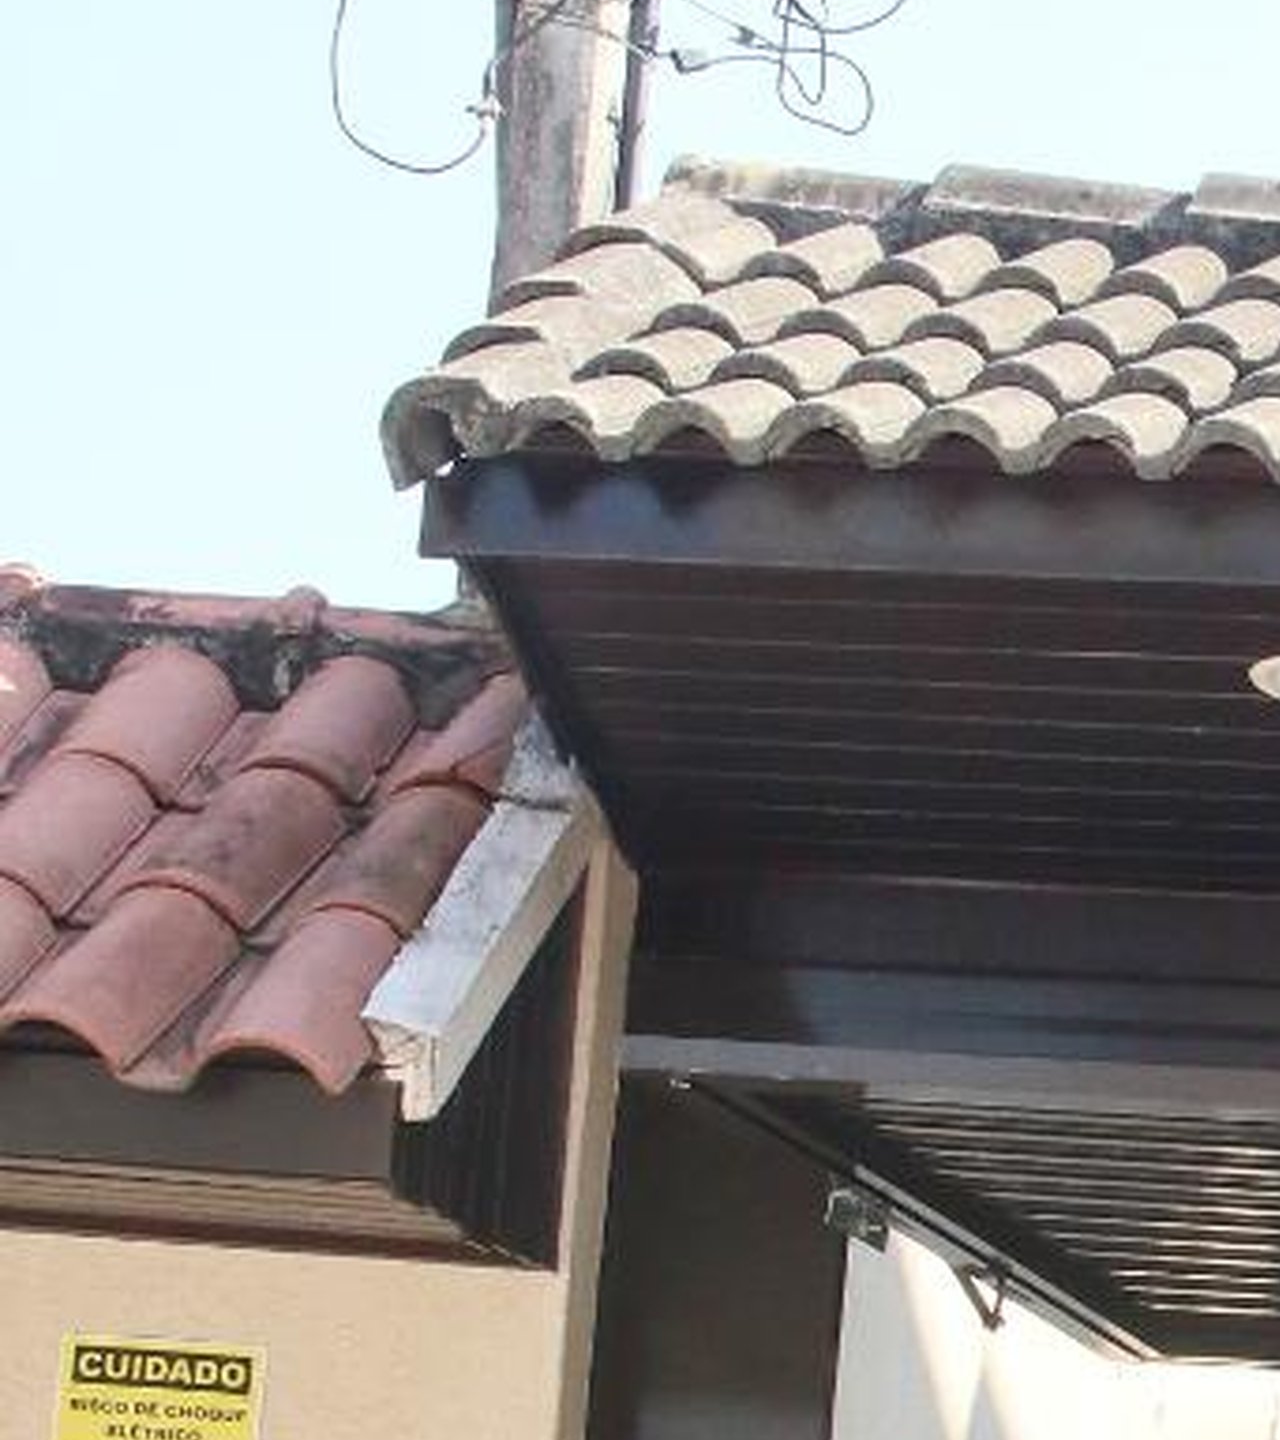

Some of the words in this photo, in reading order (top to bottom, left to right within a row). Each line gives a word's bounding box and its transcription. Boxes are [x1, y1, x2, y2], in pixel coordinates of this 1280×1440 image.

[77, 1351, 247, 1388] CUIDADO
[133, 1401, 160, 1418] DE
[164, 1404, 247, 1423] CHOQUE
